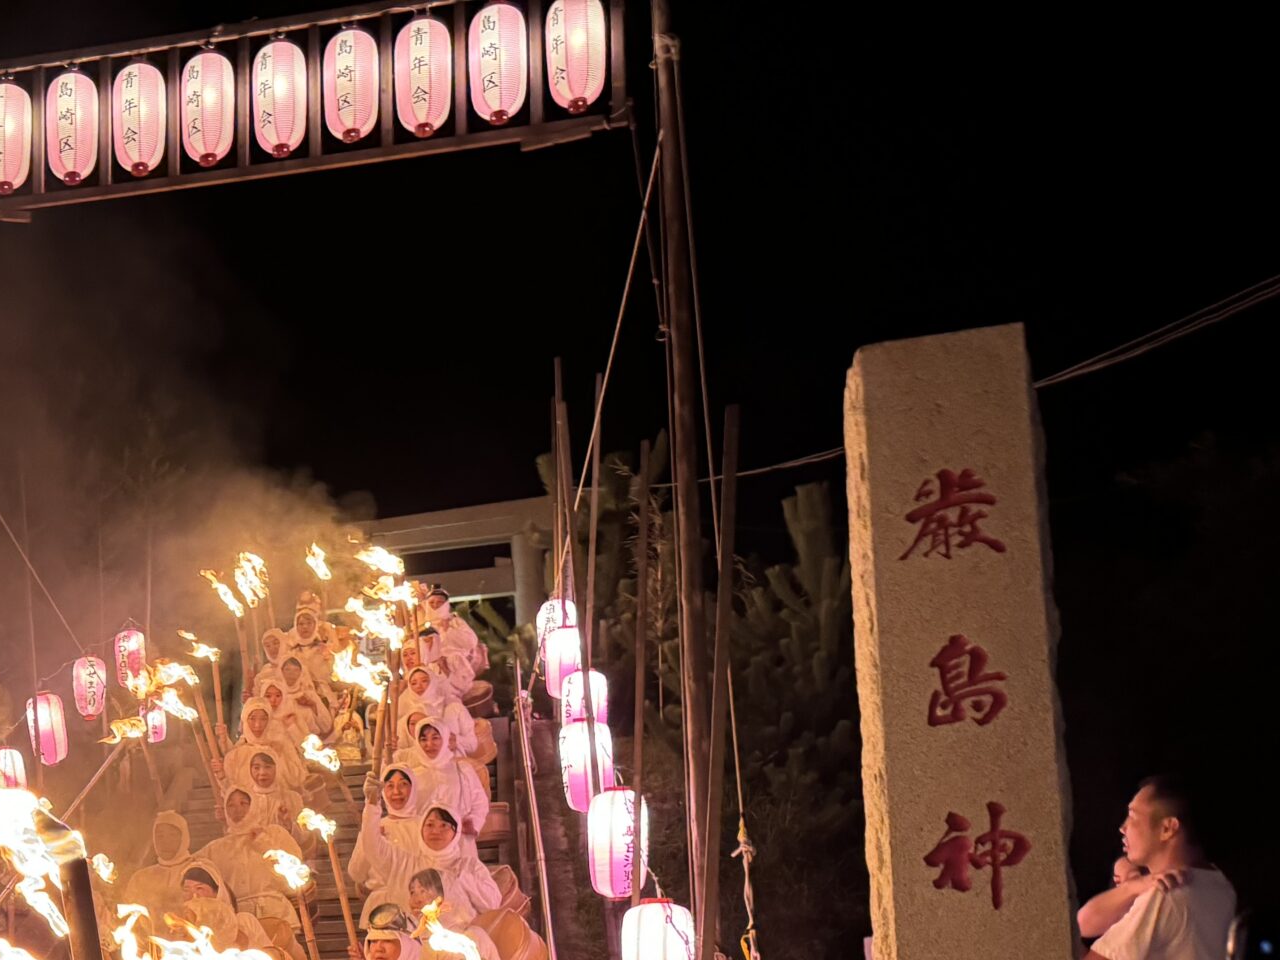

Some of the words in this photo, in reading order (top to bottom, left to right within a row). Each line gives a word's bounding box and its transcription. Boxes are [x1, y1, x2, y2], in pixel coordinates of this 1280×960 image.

[336, 39, 355, 112] 島崎区
[410, 27, 429, 106] 青年会
[481, 15, 500, 93] 島崎区
[550, 7, 566, 86] 青年会
[58, 81, 75, 154] 島崎区
[122, 71, 138, 145] 青年会
[186, 65, 202, 138] 島崎区
[258, 52, 273, 129] 青年会
